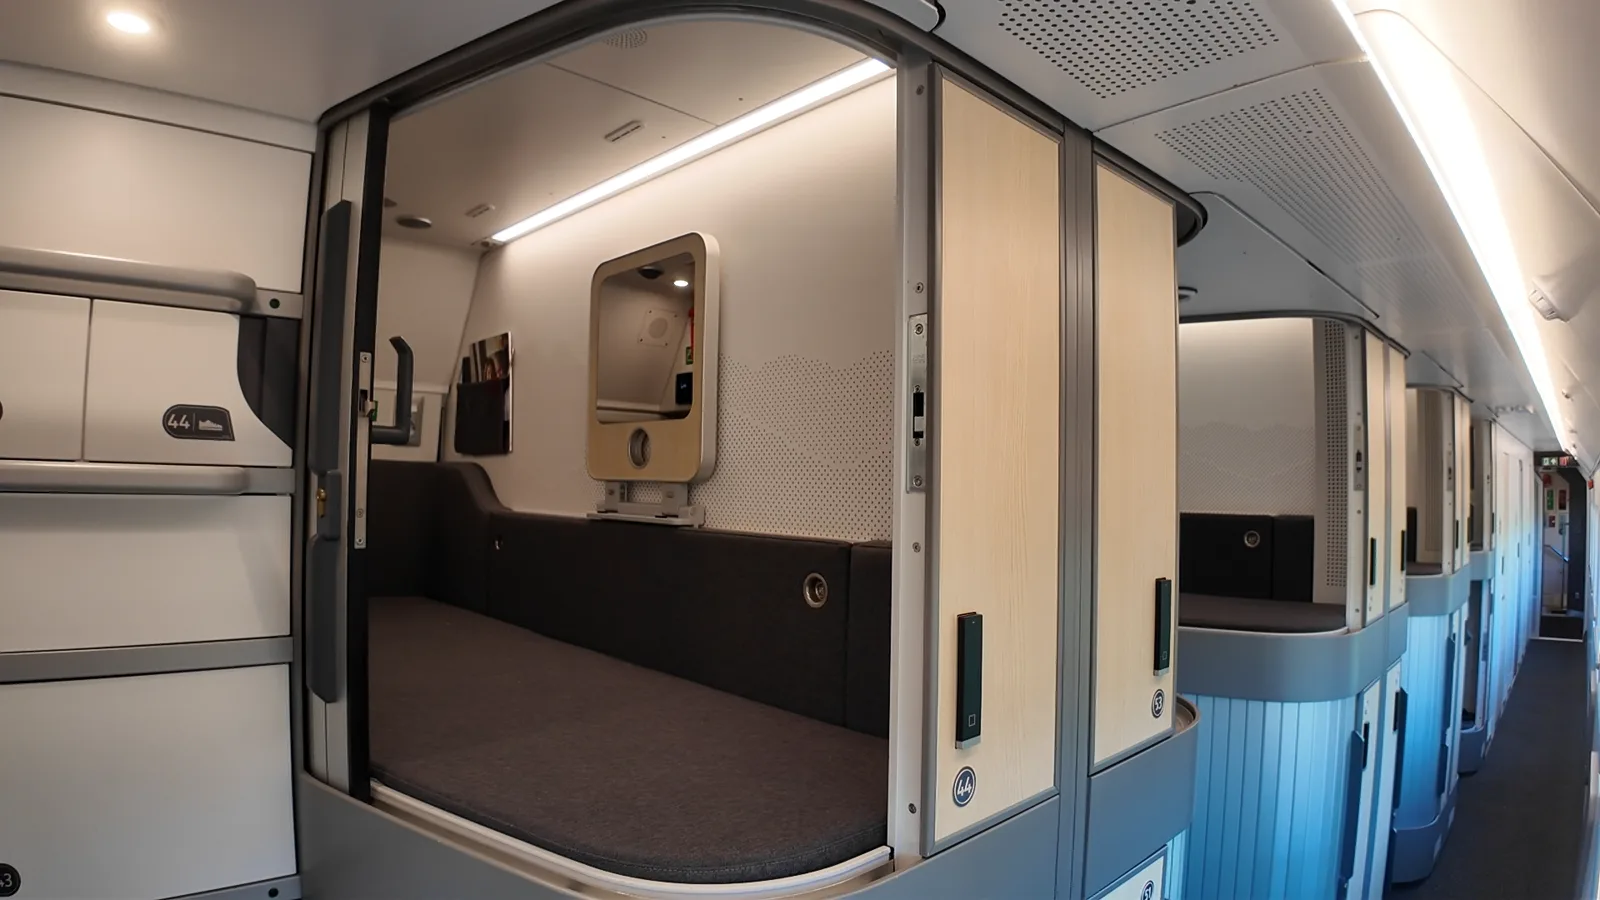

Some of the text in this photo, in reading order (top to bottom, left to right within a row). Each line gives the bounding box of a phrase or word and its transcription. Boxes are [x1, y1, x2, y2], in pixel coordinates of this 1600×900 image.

[167, 414, 190, 429] 44
[1155, 696, 1162, 711] 53
[957, 776, 972, 796] 44
